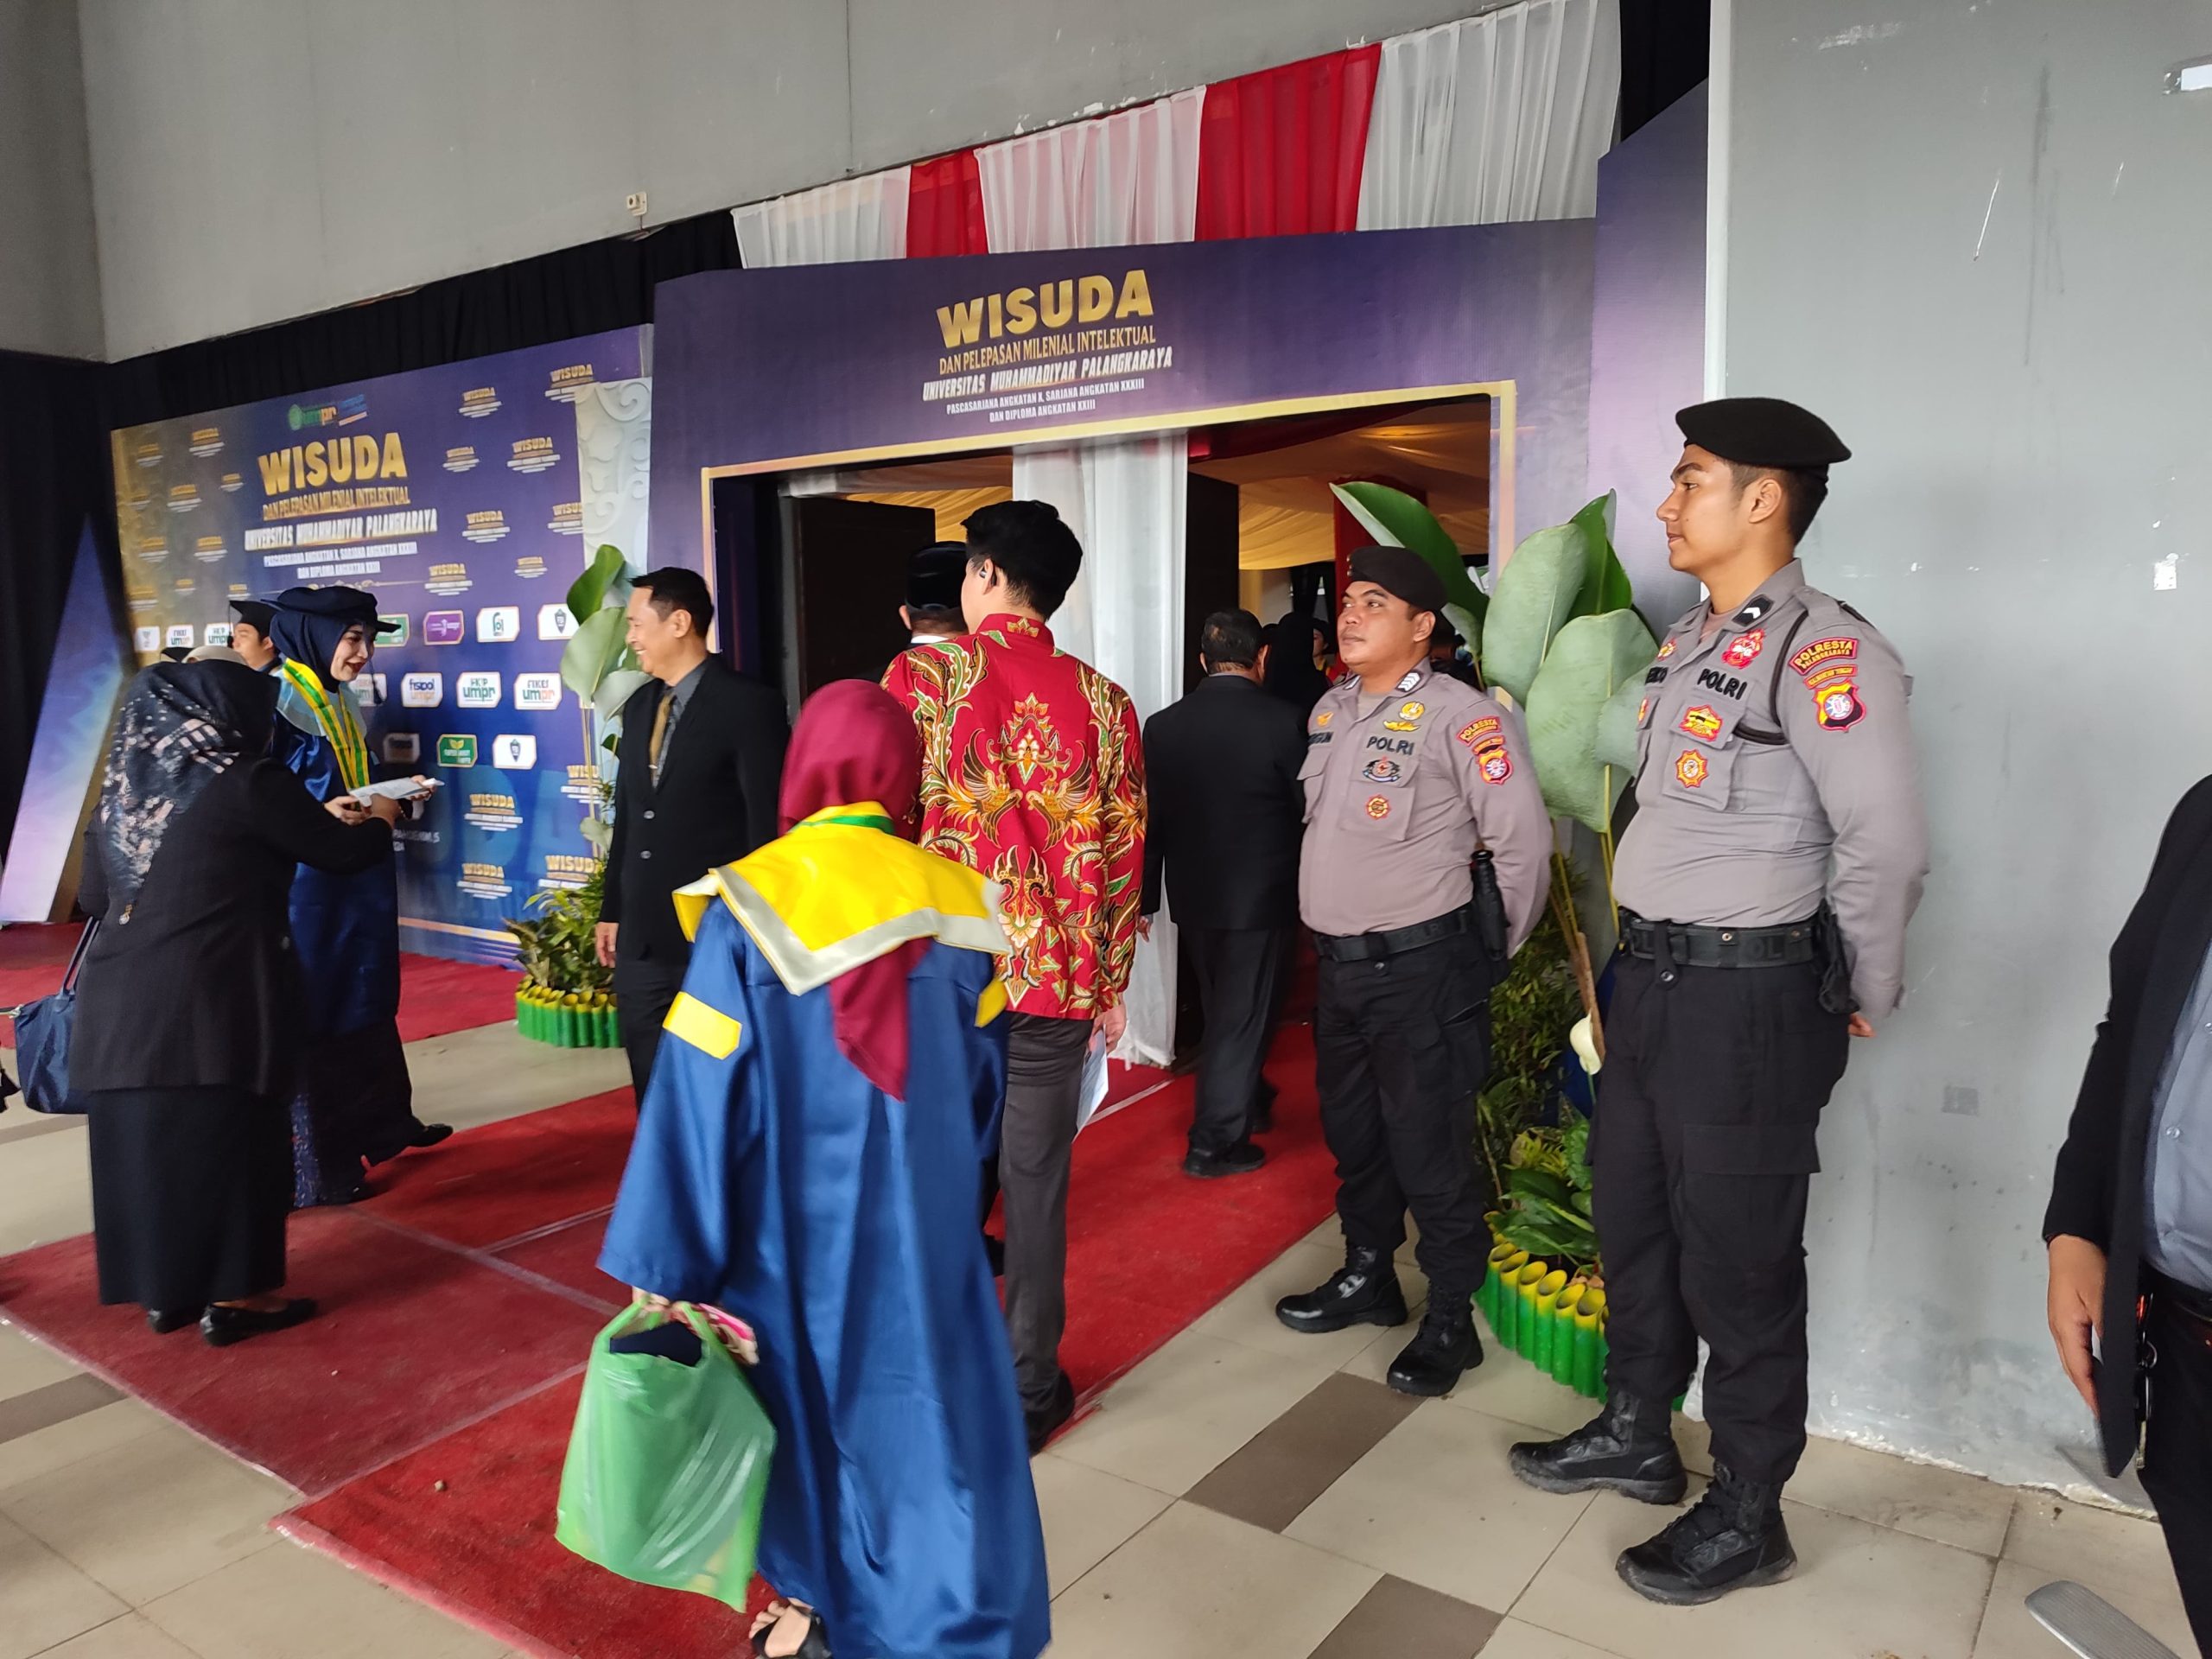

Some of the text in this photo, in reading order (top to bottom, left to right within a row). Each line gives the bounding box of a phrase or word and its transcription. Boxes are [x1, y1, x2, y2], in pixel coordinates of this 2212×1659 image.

[937, 270, 1154, 348] WISUDA
[939, 326, 1156, 375] DAN PELEPASAN MILENIAL INTELEKTUAL
[549, 364, 594, 382] WISUDA
[922, 346, 1173, 401] UNIVERSITAS MUHAMMADIYAH PALANGKARAYA
[946, 397, 999, 415] PASCASARJANA
[999, 392, 1037, 408] ANGKATAN
[1046, 385, 1078, 402] SARJANA
[1079, 381, 1120, 397] ANGKATAN
[989, 411, 1003, 423] DAN
[1005, 406, 1037, 421] DIPLOMA
[1037, 401, 1077, 416] ANGKATAN
[512, 436, 553, 453] WISUDA
[257, 432, 408, 496] WISUDA
[1794, 640, 1853, 665] POLRESTA
[463, 687, 496, 702] umpr
[1697, 668, 1747, 701] POLRI
[1366, 735, 1414, 756] POLRI
[469, 794, 515, 809] WISUDA
[461, 863, 505, 879] WISUDA
